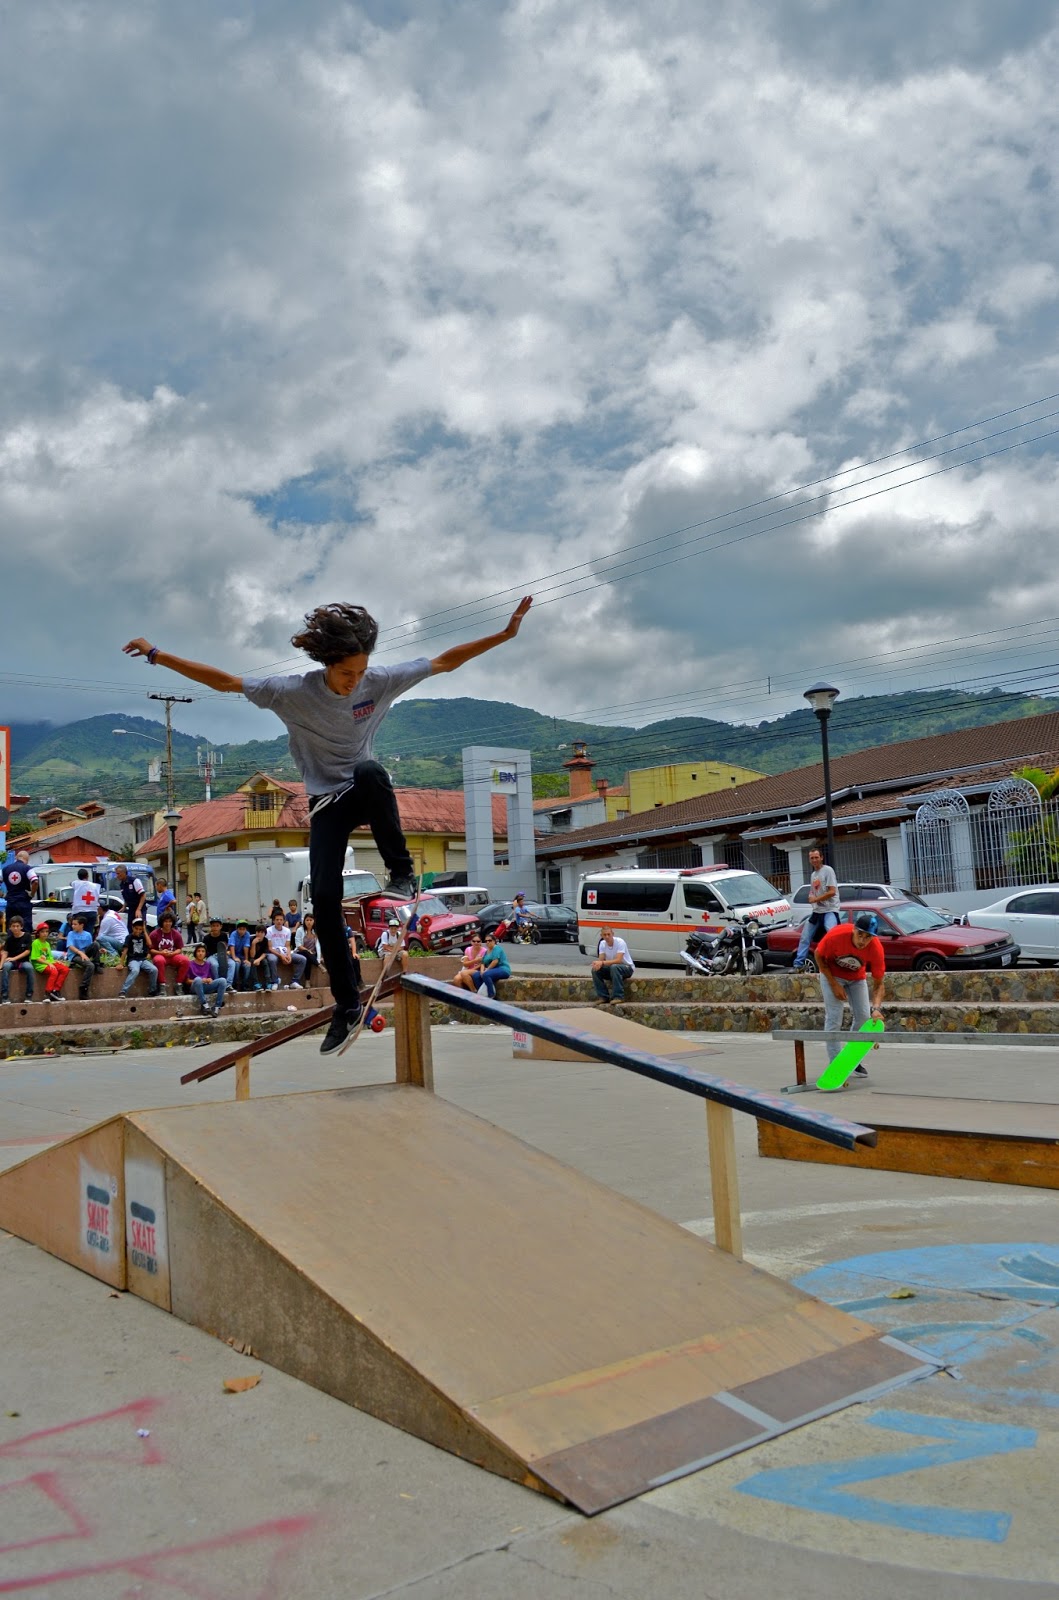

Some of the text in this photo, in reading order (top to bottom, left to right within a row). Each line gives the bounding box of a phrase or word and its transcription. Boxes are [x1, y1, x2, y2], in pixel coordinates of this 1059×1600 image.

[353, 704, 375, 719] SKATE
[87, 1201, 109, 1235] SKATE
[132, 1220, 156, 1256] SKATE
